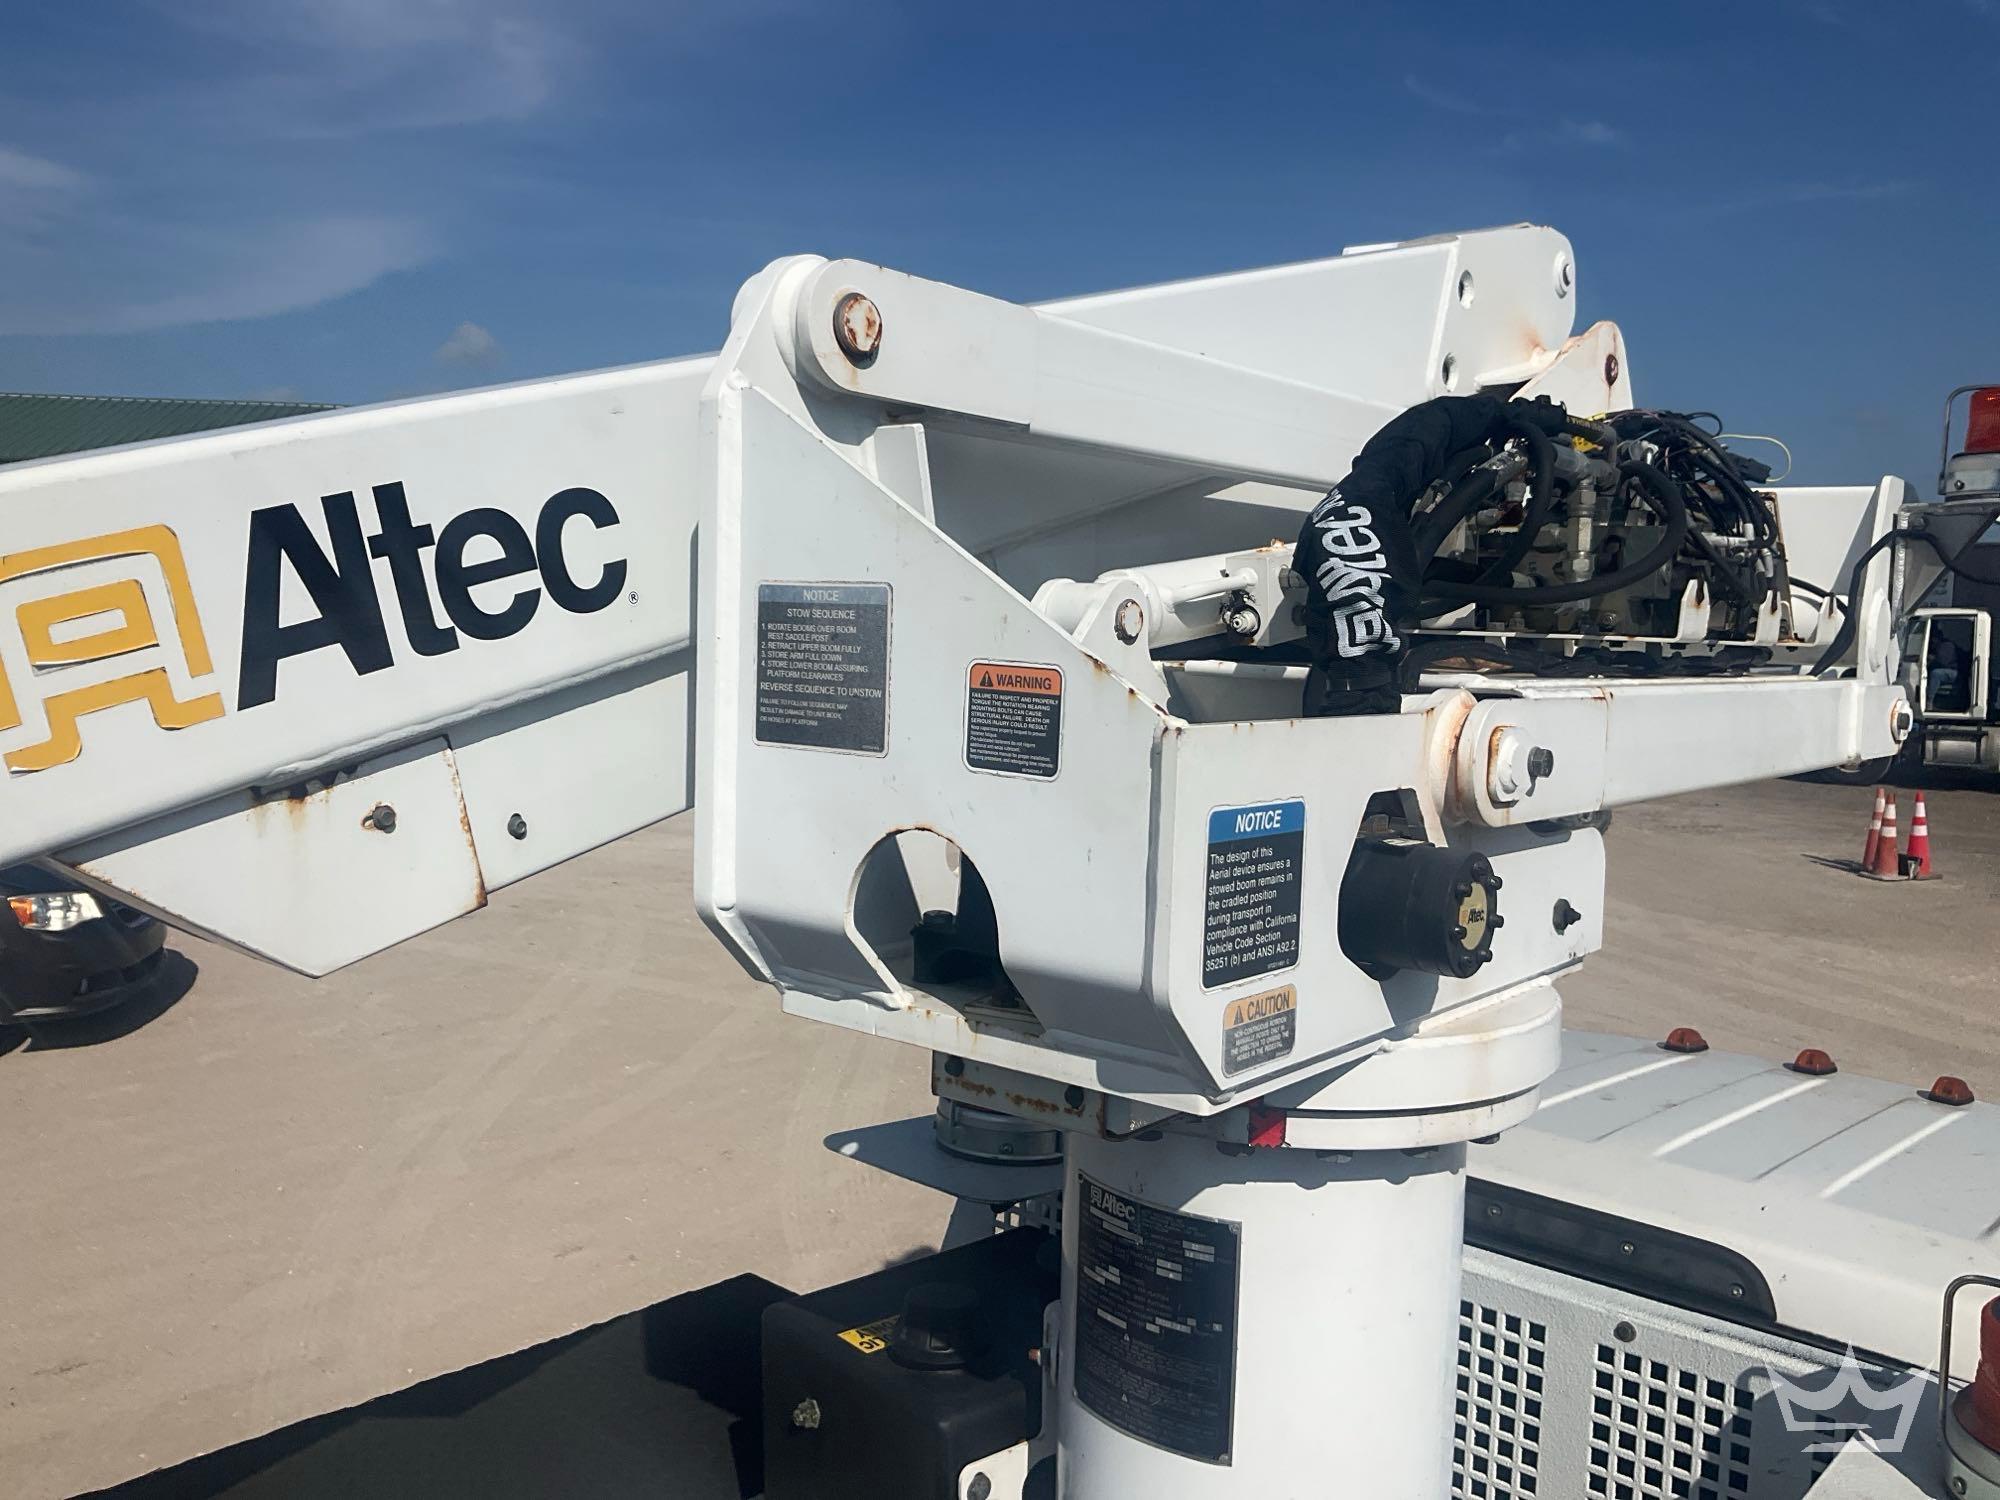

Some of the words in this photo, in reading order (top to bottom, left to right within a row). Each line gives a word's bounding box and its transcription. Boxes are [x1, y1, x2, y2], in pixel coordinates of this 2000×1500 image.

[237, 481, 628, 712] Altec
[803, 589, 840, 601] NOTICE
[787, 608, 810, 618] STOW
[812, 609, 856, 620] SEQUENCE
[768, 623, 792, 632] ROTATE
[792, 624, 816, 633] BOOMS
[817, 625, 836, 633] OVER
[836, 626, 856, 634] BOOM
[768, 632, 783, 641] REST
[785, 633, 810, 642] SADDLE
[811, 634, 828, 642] POST
[768, 642, 796, 650] RETRACT
[798, 643, 819, 651] UPPER
[820, 644, 840, 652] BOOM
[841, 645, 861, 654] FULLY
[768, 651, 788, 659] STORE
[790, 652, 804, 660] ARM
[805, 653, 819, 661] FULL
[822, 654, 842, 662] DOWN
[767, 670, 800, 678] PLATFORM
[801, 672, 844, 681] CLEARANCES
[768, 661, 788, 669] STORE
[790, 662, 812, 670] LOWER
[814, 662, 833, 670] BOOM
[834, 664, 868, 673] ASSURING
[760, 682, 793, 692] REVERSE
[794, 684, 835, 694] SEQUENCE
[837, 687, 848, 696] TO
[849, 688, 882, 698] UNSTOW
[996, 674, 1052, 690] WARNING
[971, 711, 1001, 719] STRUCTURAL
[1235, 810, 1282, 833] NOTICE
[1210, 854, 1224, 864] The
[1226, 850, 1250, 863] design
[1252, 847, 1259, 858] of
[1260, 846, 1273, 857] this
[1209, 867, 1230, 880] Aerial
[1232, 864, 1255, 876] device
[1257, 860, 1284, 872] ensures
[1286, 859, 1290, 868] a
[1209, 882, 1235, 896] stowed
[1236, 879, 1256, 890] boom
[1258, 874, 1285, 886] remains
[1286, 872, 1293, 881] in
[1208, 900, 1219, 911] the
[1222, 893, 1248, 908] cradled
[1250, 890, 1277, 904] position
[1207, 913, 1230, 926] during
[1232, 905, 1264, 920] transport
[1265, 904, 1272, 913] in
[1207, 924, 1248, 941] compliance
[1250, 920, 1264, 931] with
[1265, 913, 1296, 928] California
[1206, 941, 1233, 956] Vehicle
[1234, 937, 1254, 950] Code
[1256, 931, 1281, 944] Section
[1206, 957, 1228, 972] 35251
[1231, 953, 1240, 967] (b)
[1242, 949, 1256, 962] and
[1257, 944, 1274, 958] ANSI
[1248, 991, 1290, 1020] CAUTION
[1102, 1192, 1136, 1220] Altec
